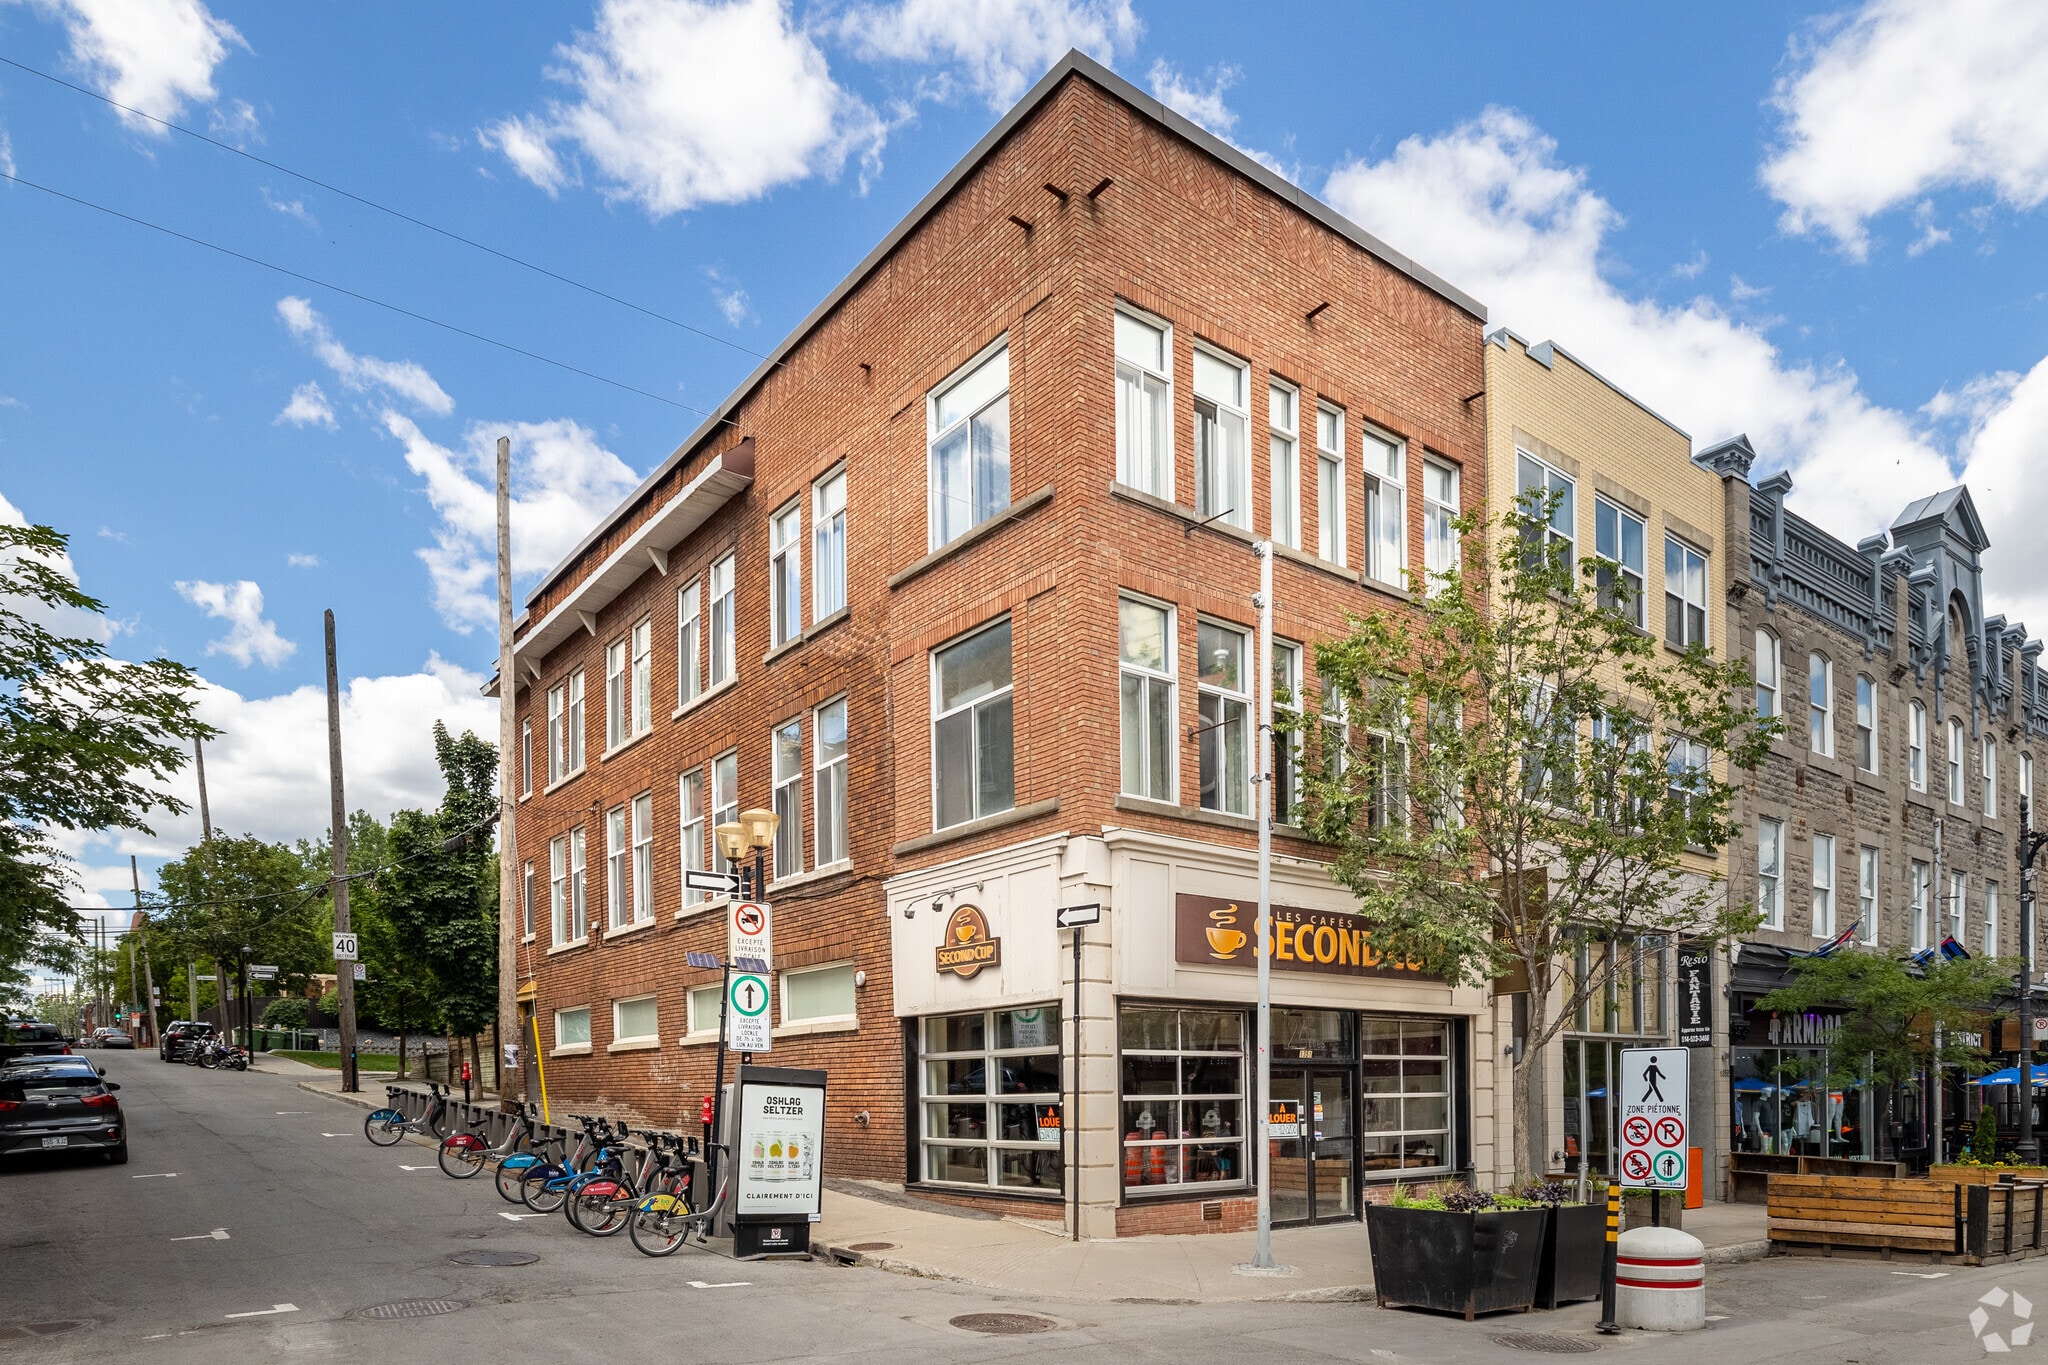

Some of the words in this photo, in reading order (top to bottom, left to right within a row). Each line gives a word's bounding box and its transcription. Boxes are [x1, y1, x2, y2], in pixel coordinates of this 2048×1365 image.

[1276, 911, 1301, 923] LES
[1310, 914, 1353, 929] CAFÉS
[336, 939, 355, 953] 40
[735, 945, 766, 953] LIVRAISON
[1688, 969, 1701, 1025] FANTASIE
[766, 1096, 801, 1106] OSHLAG
[763, 1106, 803, 1115] SELTZER
[1627, 1105, 1645, 1114] ZONE
[1647, 1103, 1681, 1114] PIÉTONNE
[1040, 1117, 1060, 1128] LOUE
[1269, 1113, 1296, 1123] LOUER
